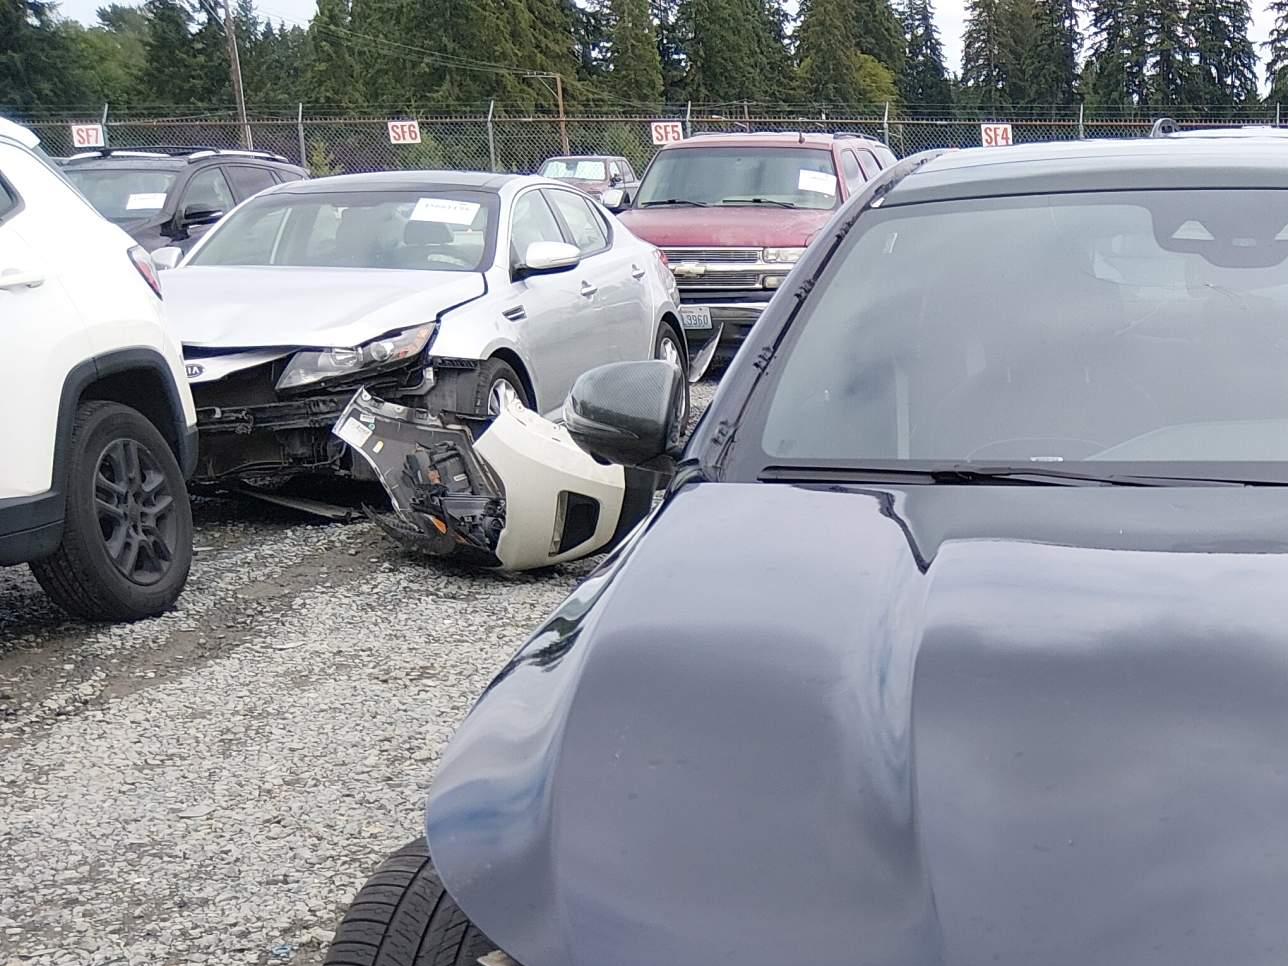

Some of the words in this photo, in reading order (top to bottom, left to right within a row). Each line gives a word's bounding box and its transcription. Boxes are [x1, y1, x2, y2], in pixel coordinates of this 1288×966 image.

[76, 128, 99, 145] SF7
[391, 124, 418, 141] SF6
[654, 124, 681, 142] SF5
[984, 127, 1010, 146] SF4
